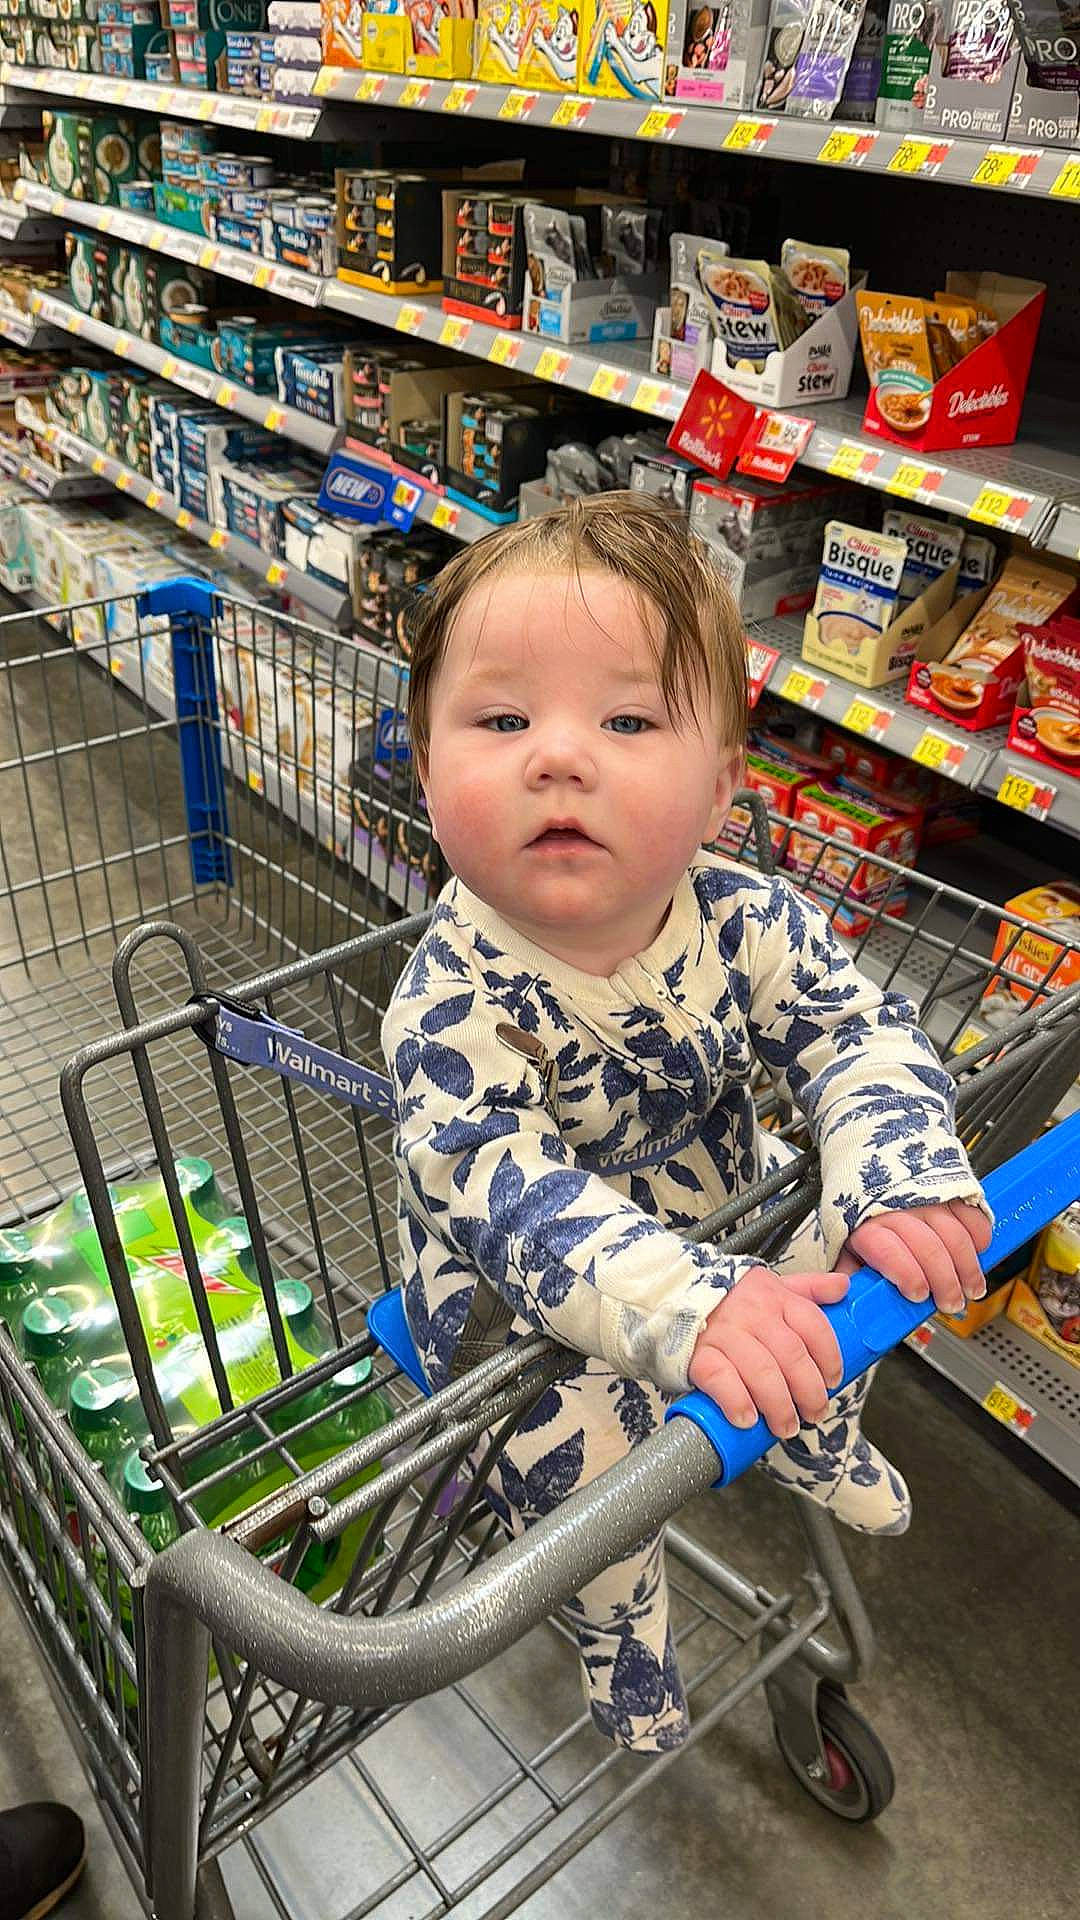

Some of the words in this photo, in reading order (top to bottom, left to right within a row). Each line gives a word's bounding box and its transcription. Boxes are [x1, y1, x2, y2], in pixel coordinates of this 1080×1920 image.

[217, 1, 257, 23] ONE
[892, 2, 925, 29] PRO
[941, 108, 972, 130] PRO
[1027, 117, 1057, 139] PRO
[679, 430, 723, 470] Rollback
[329, 472, 370, 500] NEW
[829, 541, 895, 581] Bisque
[1004, 779, 1029, 799] 112
[267, 1037, 373, 1102] Walmart
[599, 1117, 696, 1168] Walmart
